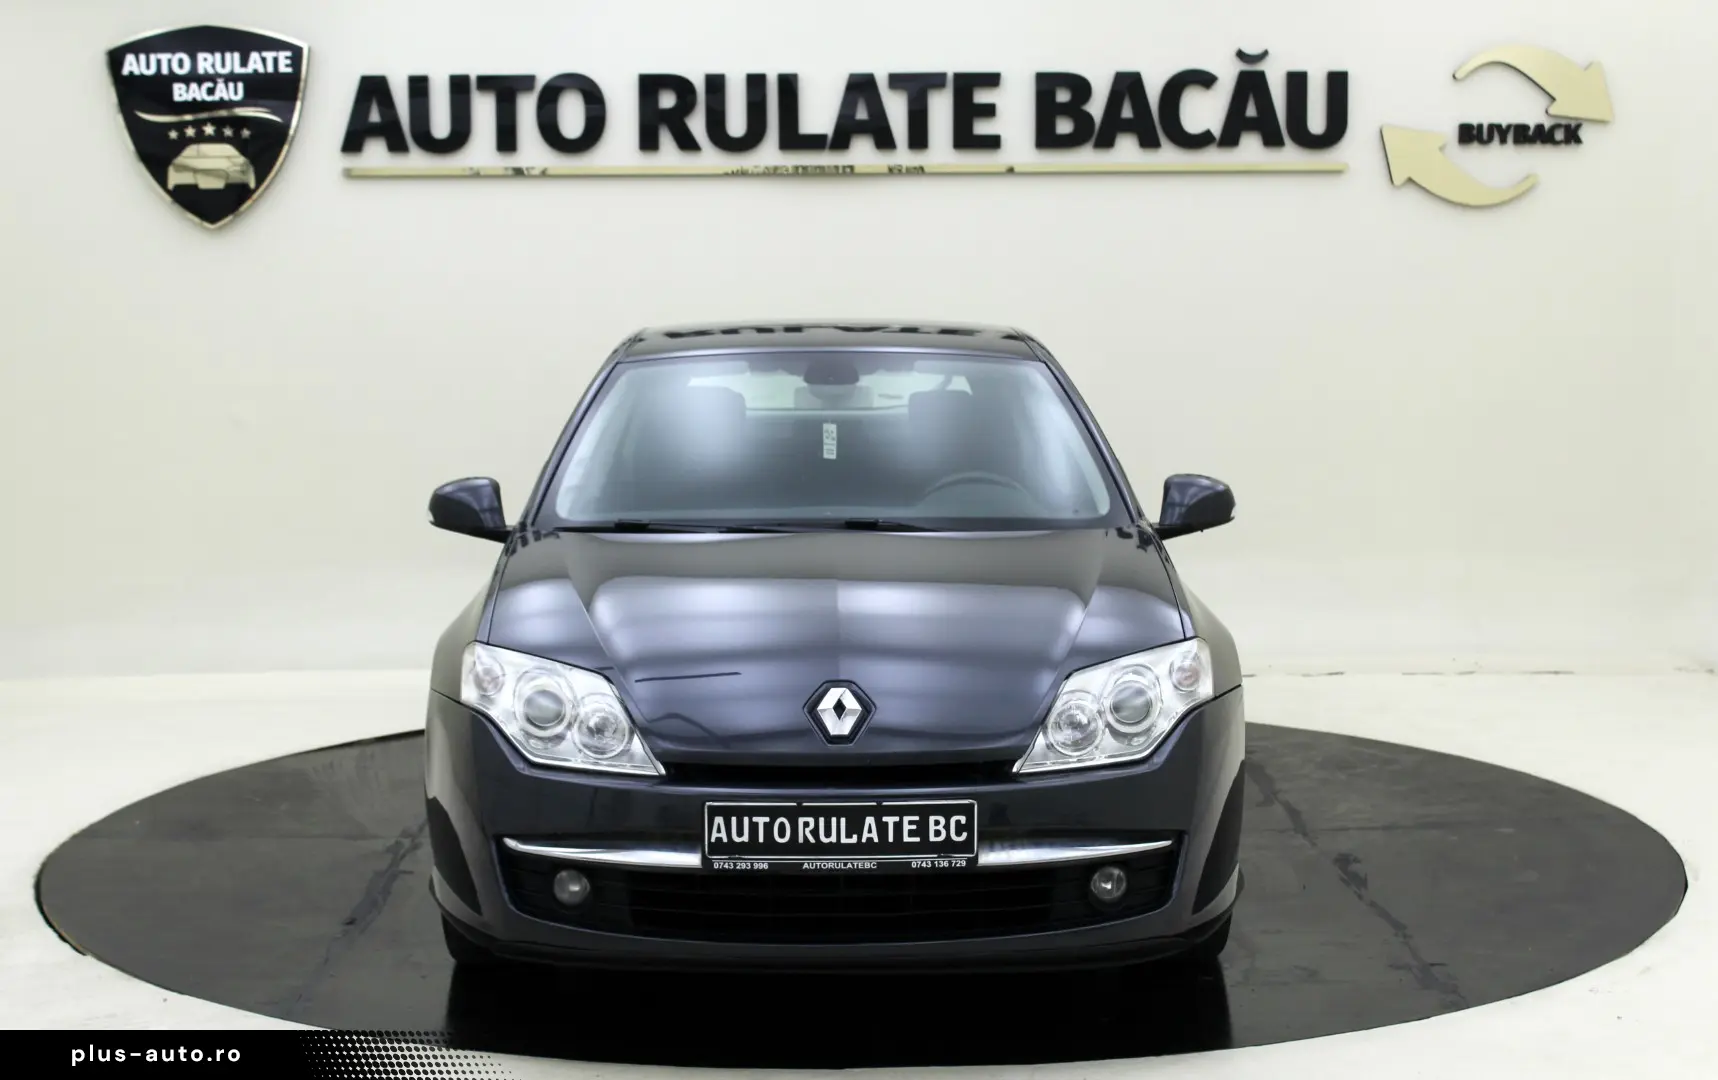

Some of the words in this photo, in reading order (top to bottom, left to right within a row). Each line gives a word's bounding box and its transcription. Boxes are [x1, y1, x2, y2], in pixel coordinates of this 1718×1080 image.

[122, 52, 191, 76] AUTO
[196, 50, 293, 75] RULATE
[172, 78, 244, 102] BACĂU
[341, 72, 607, 154] AUTO
[638, 72, 1002, 153] RULATE
[1034, 48, 1349, 151] BACĂU
[1457, 122, 1583, 146] BUYBACK
[710, 816, 791, 844] AUTO
[797, 816, 921, 844] RULATE
[928, 815, 968, 842] BC
[713, 862, 735, 870] 0743
[735, 862, 752, 870] 293
[752, 862, 769, 870] 996
[802, 861, 878, 870] AUTORULATEBC
[911, 860, 932, 868] 0743
[933, 860, 950, 868] 136
[950, 859, 967, 868] 729
